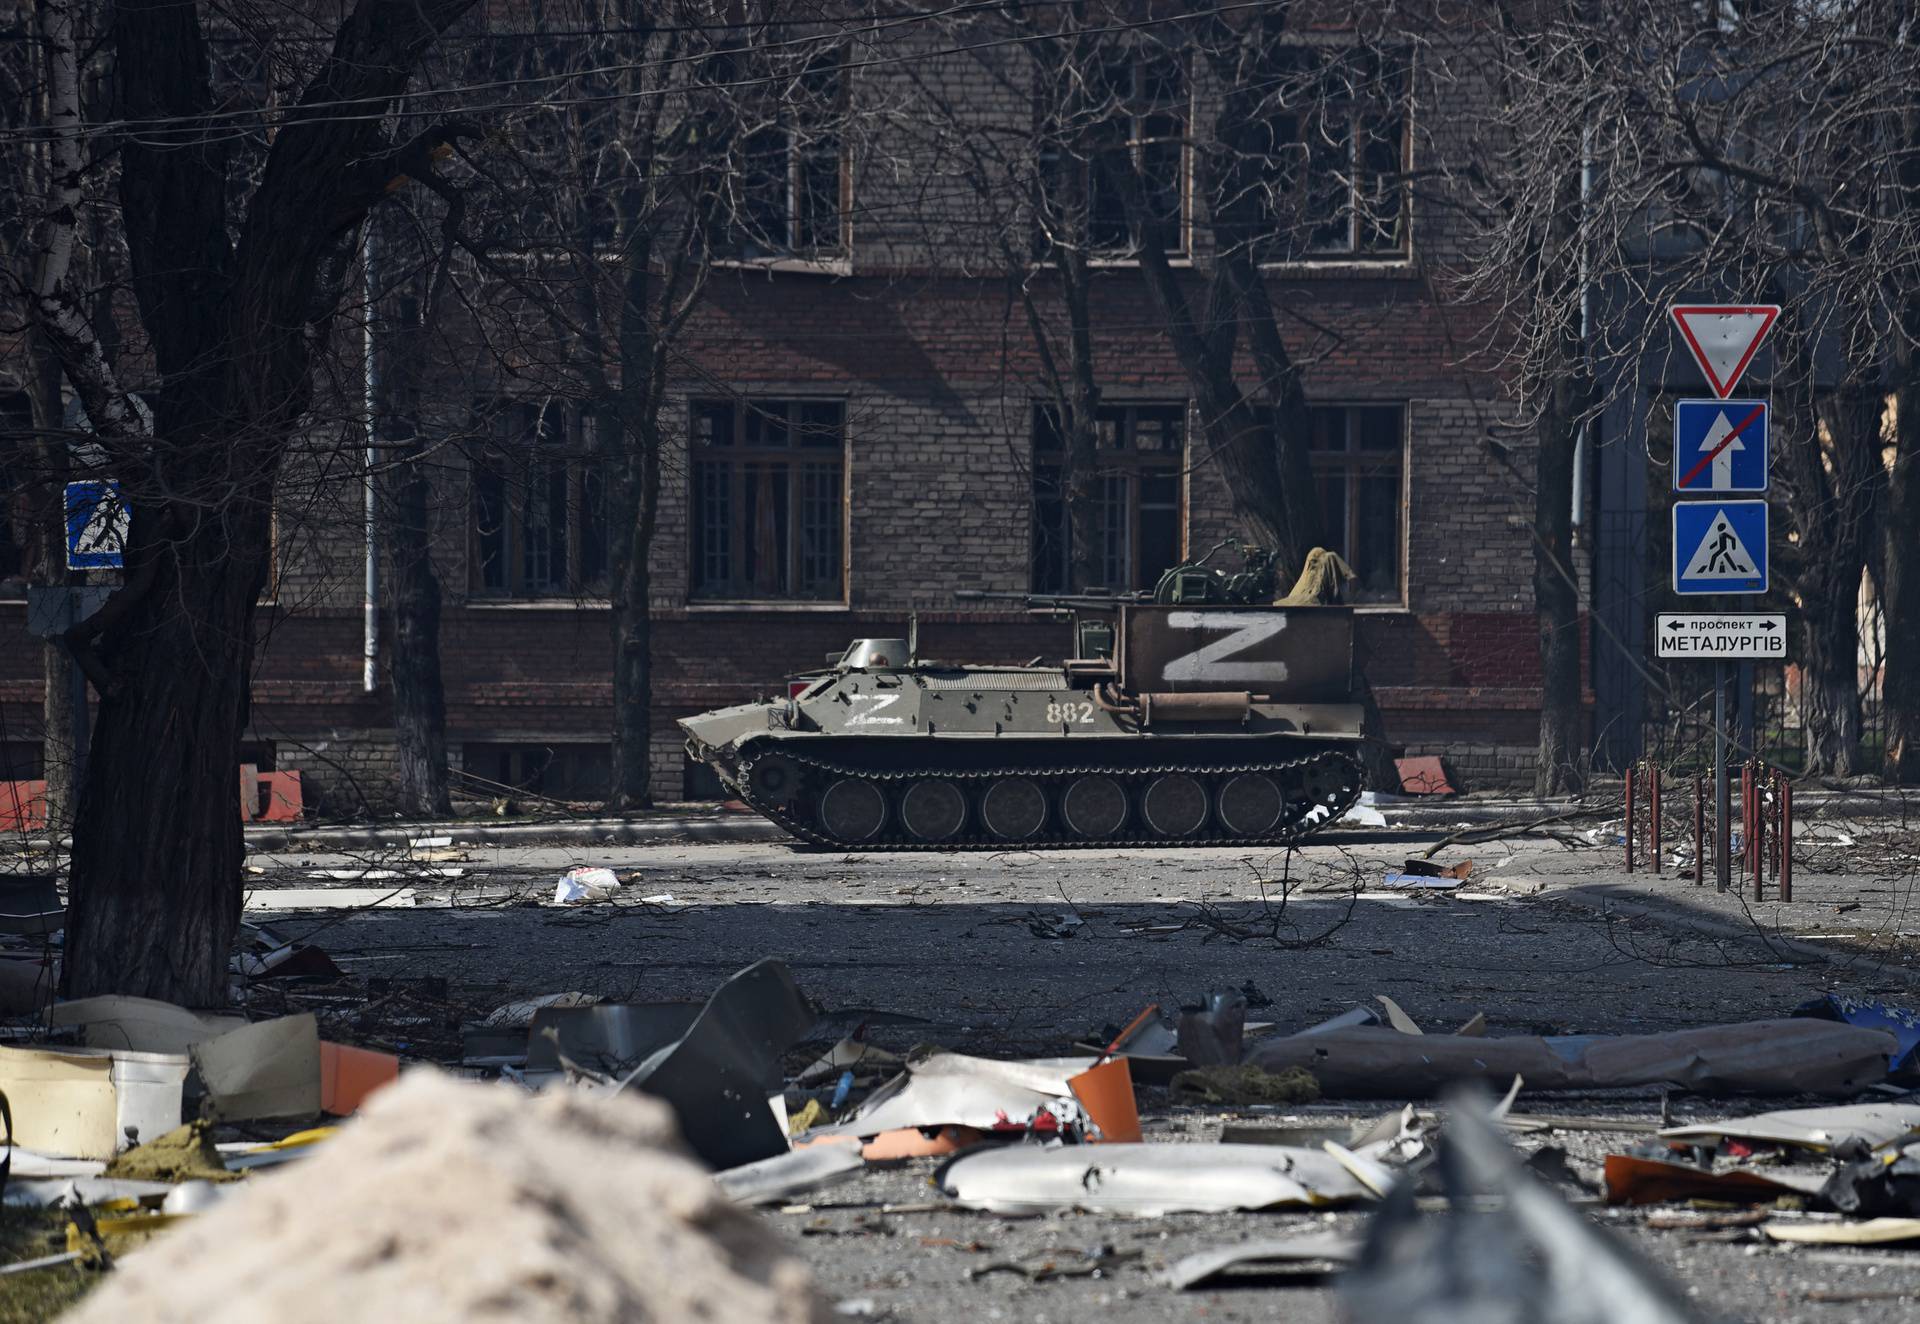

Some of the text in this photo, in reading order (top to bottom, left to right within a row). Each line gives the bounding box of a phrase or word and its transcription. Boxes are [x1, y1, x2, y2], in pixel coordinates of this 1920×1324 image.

[1690, 621, 1753, 632] проспект
[1162, 611, 1288, 682] Z
[1661, 636, 1783, 652] МЕТАЛУРГІВ
[844, 694, 904, 727] Z
[1046, 702, 1095, 724] 882
